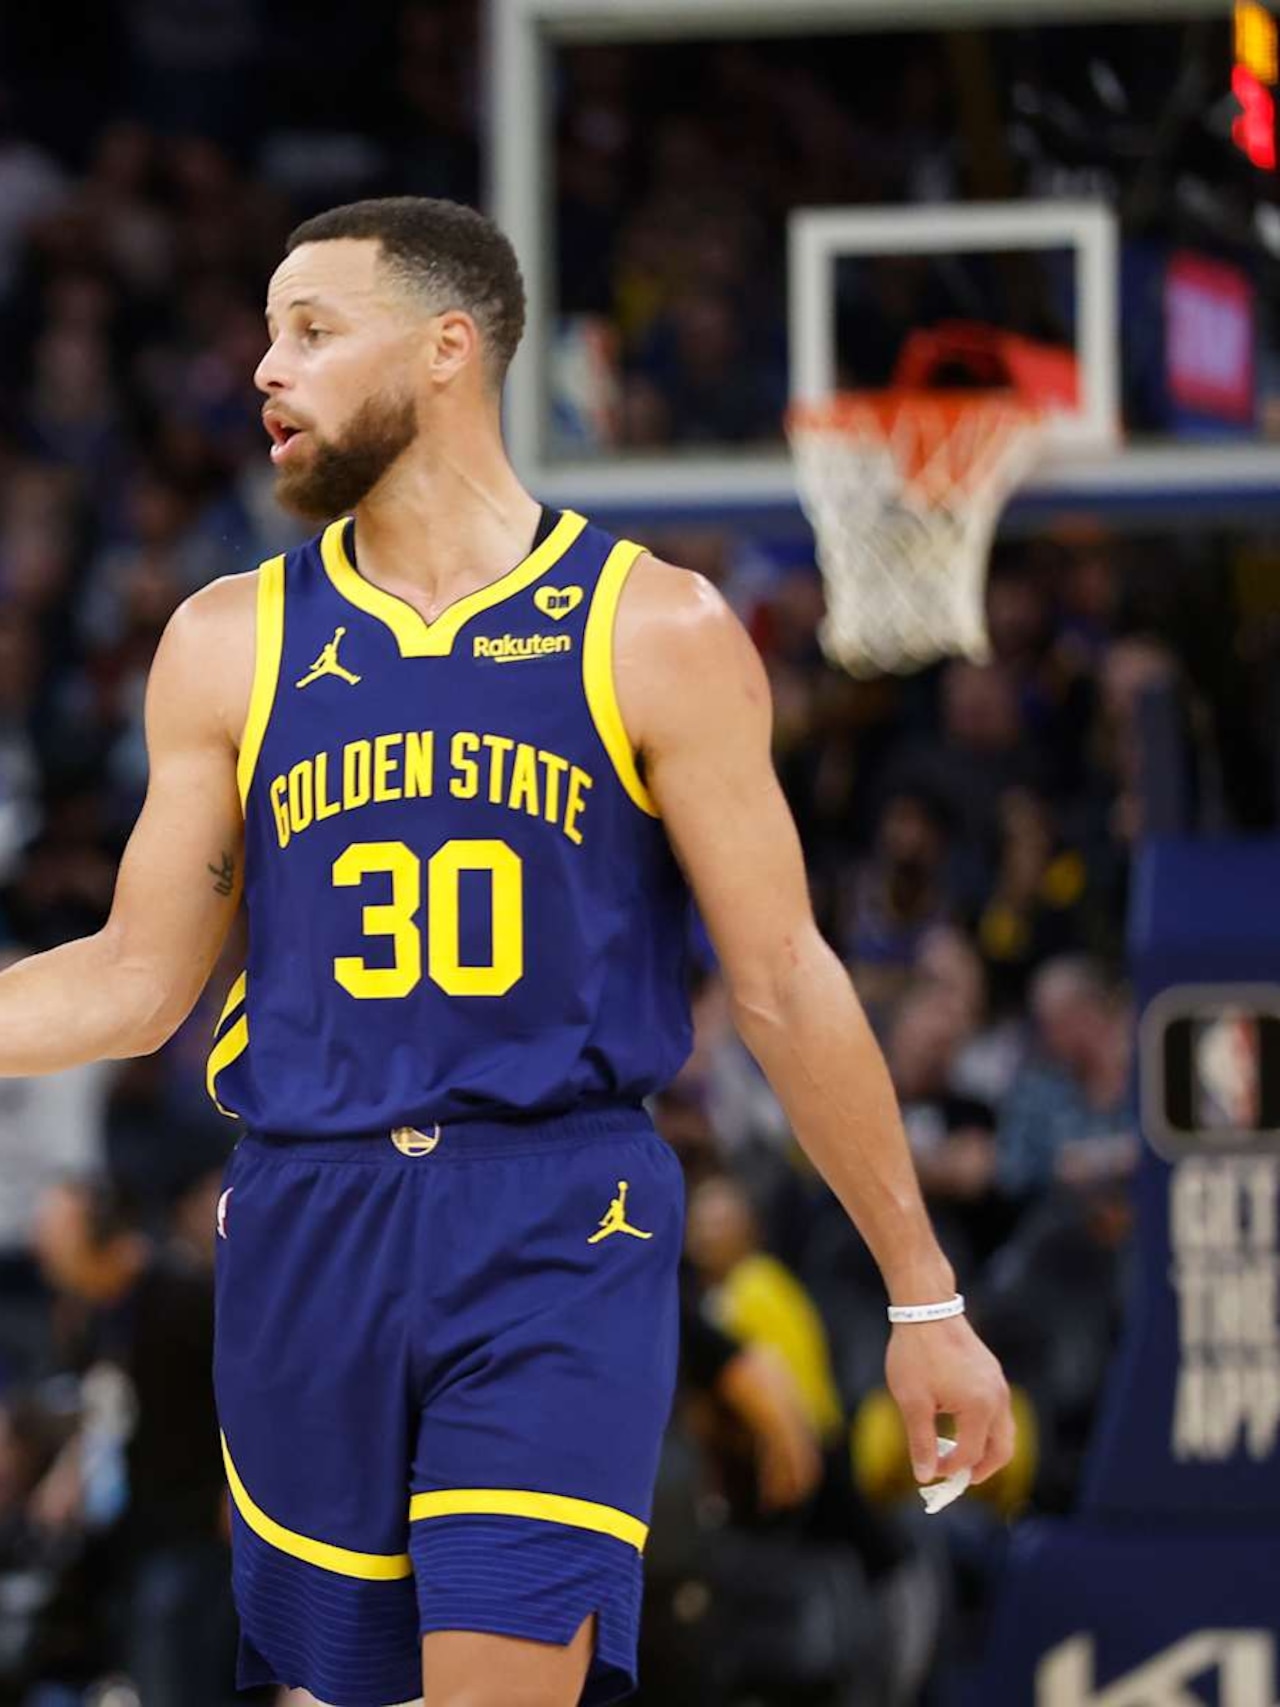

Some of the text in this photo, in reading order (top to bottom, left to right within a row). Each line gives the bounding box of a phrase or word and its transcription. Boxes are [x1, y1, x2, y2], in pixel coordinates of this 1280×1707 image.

[547, 595, 570, 610] DM
[473, 633, 571, 663] Rakuten
[269, 730, 593, 849] GOLDEN STATE
[332, 839, 523, 999] 30
